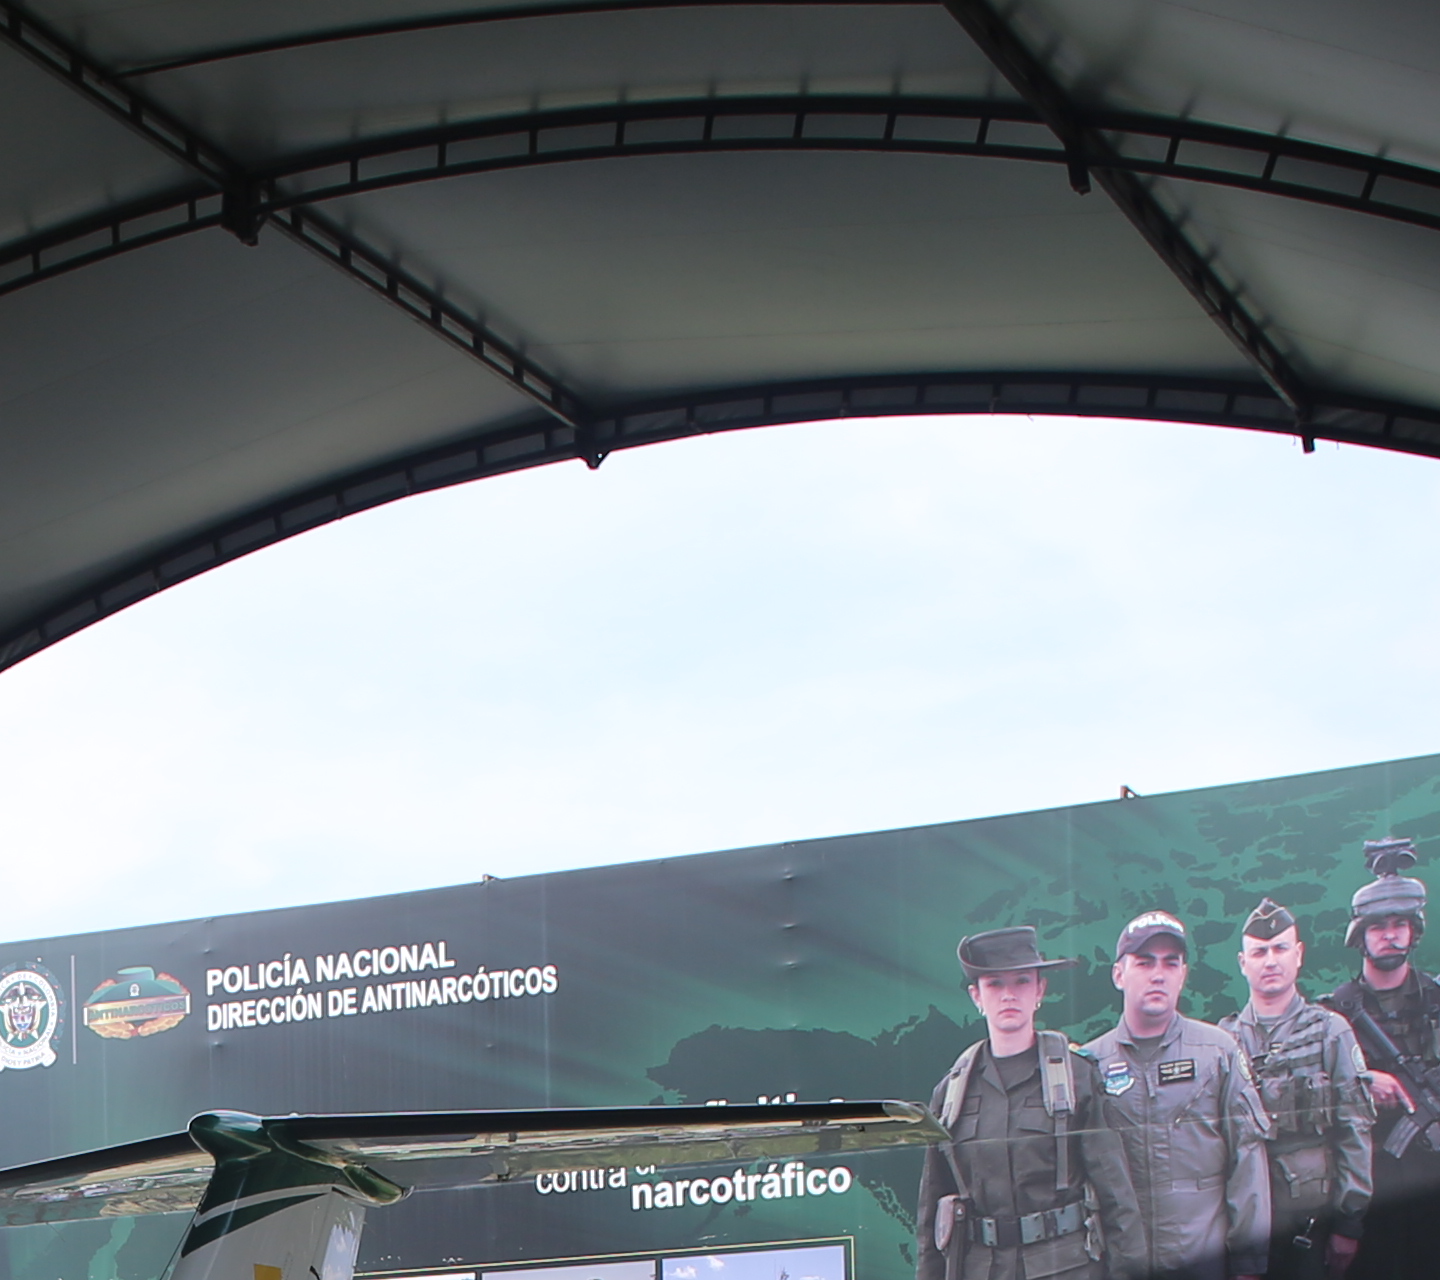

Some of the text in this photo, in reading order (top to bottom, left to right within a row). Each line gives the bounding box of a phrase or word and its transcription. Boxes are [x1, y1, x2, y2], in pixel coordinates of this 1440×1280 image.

[206, 941, 455, 996] POLICÍA NACIONAL
[207, 965, 559, 1031] DIRECCIÓN DE ANTINARCÓTICOS
[631, 1160, 853, 1211] narcotráfico
